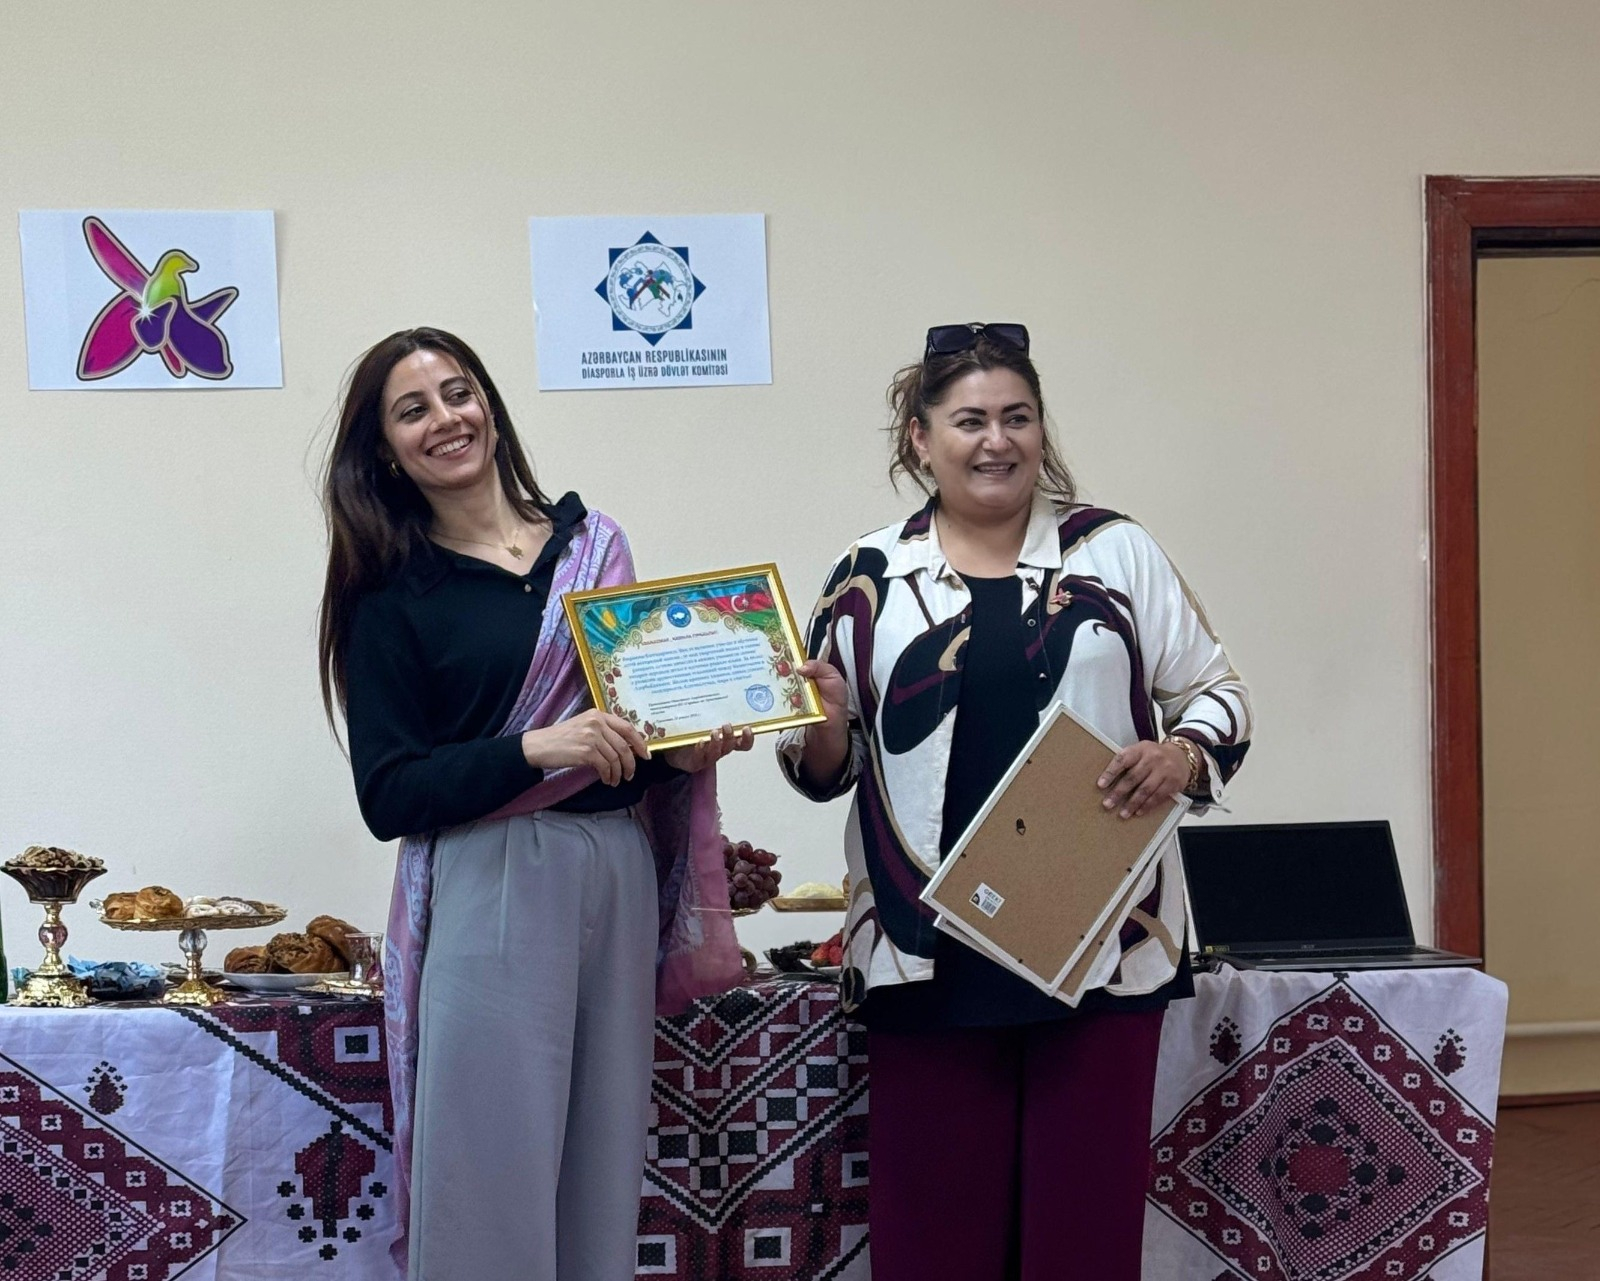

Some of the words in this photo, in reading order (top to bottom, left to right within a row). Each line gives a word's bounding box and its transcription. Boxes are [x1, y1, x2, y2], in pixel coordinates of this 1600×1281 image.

[581, 351, 642, 365] AZƏRBAYCAN
[645, 348, 727, 363] RESPUBLİKASININ
[582, 366, 625, 379] DİASPORLA
[627, 365, 636, 381] İŞ
[638, 365, 658, 378] ÜZRƏ
[661, 364, 689, 377] DÖVLƏT
[691, 363, 728, 376] KOMİTƏSİ
